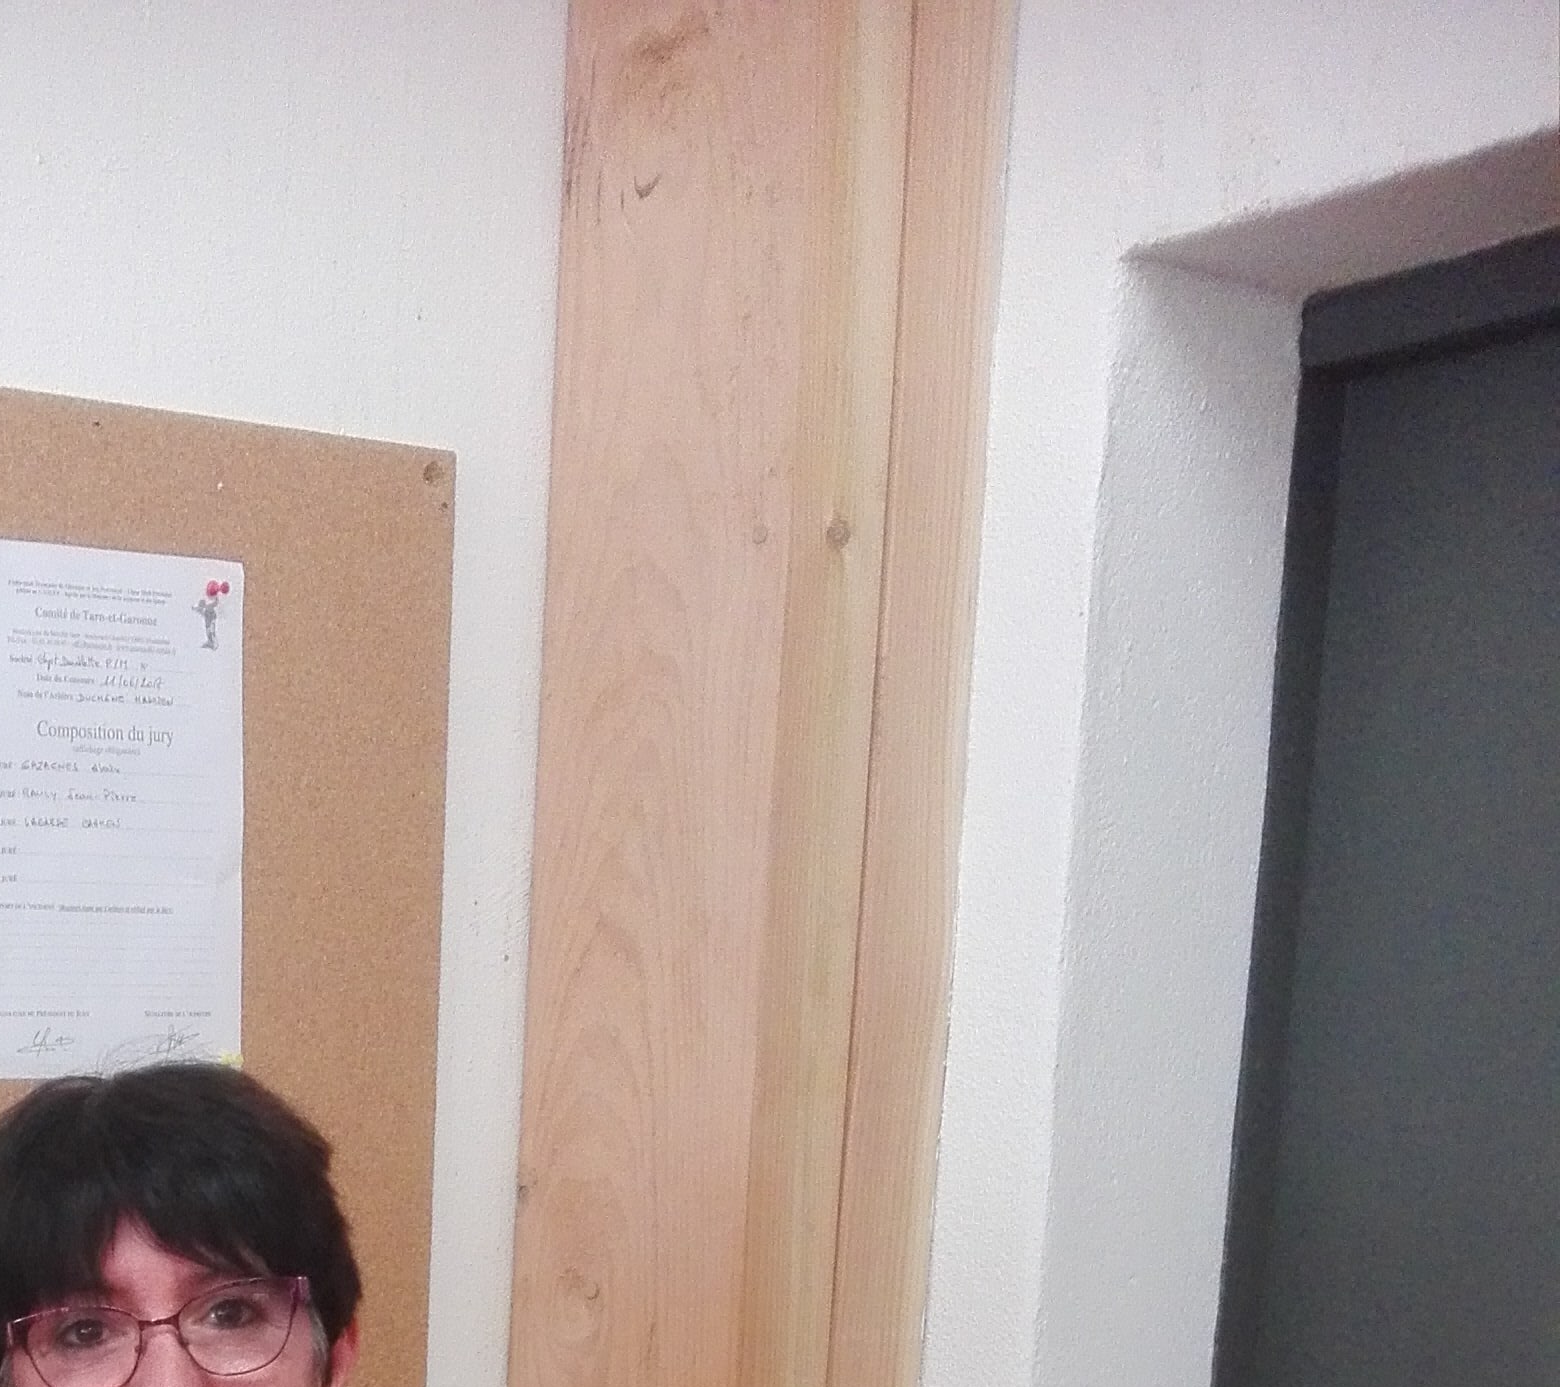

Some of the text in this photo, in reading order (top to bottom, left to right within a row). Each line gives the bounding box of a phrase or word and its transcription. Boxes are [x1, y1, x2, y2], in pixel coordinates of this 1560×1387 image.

[35, 606, 68, 619] Comité
[70, 609, 81, 620] de
[36, 719, 174, 747] Composition du jury
